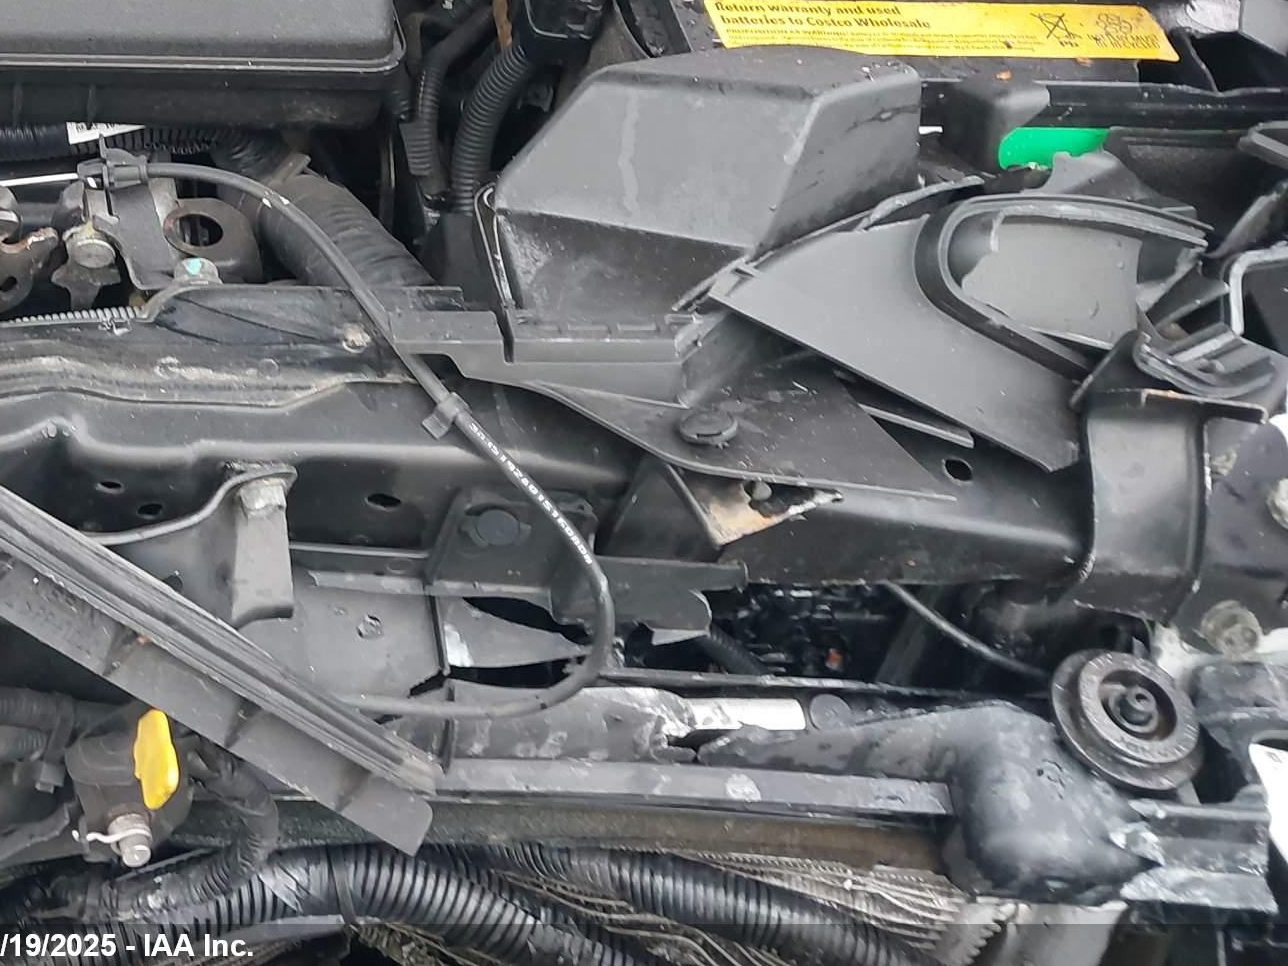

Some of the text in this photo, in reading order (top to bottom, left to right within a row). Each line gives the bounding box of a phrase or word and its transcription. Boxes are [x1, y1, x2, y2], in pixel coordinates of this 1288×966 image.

[714, 1, 902, 17] Return warranty and used
[720, 14, 931, 29] batteries to Costco Wholesale
